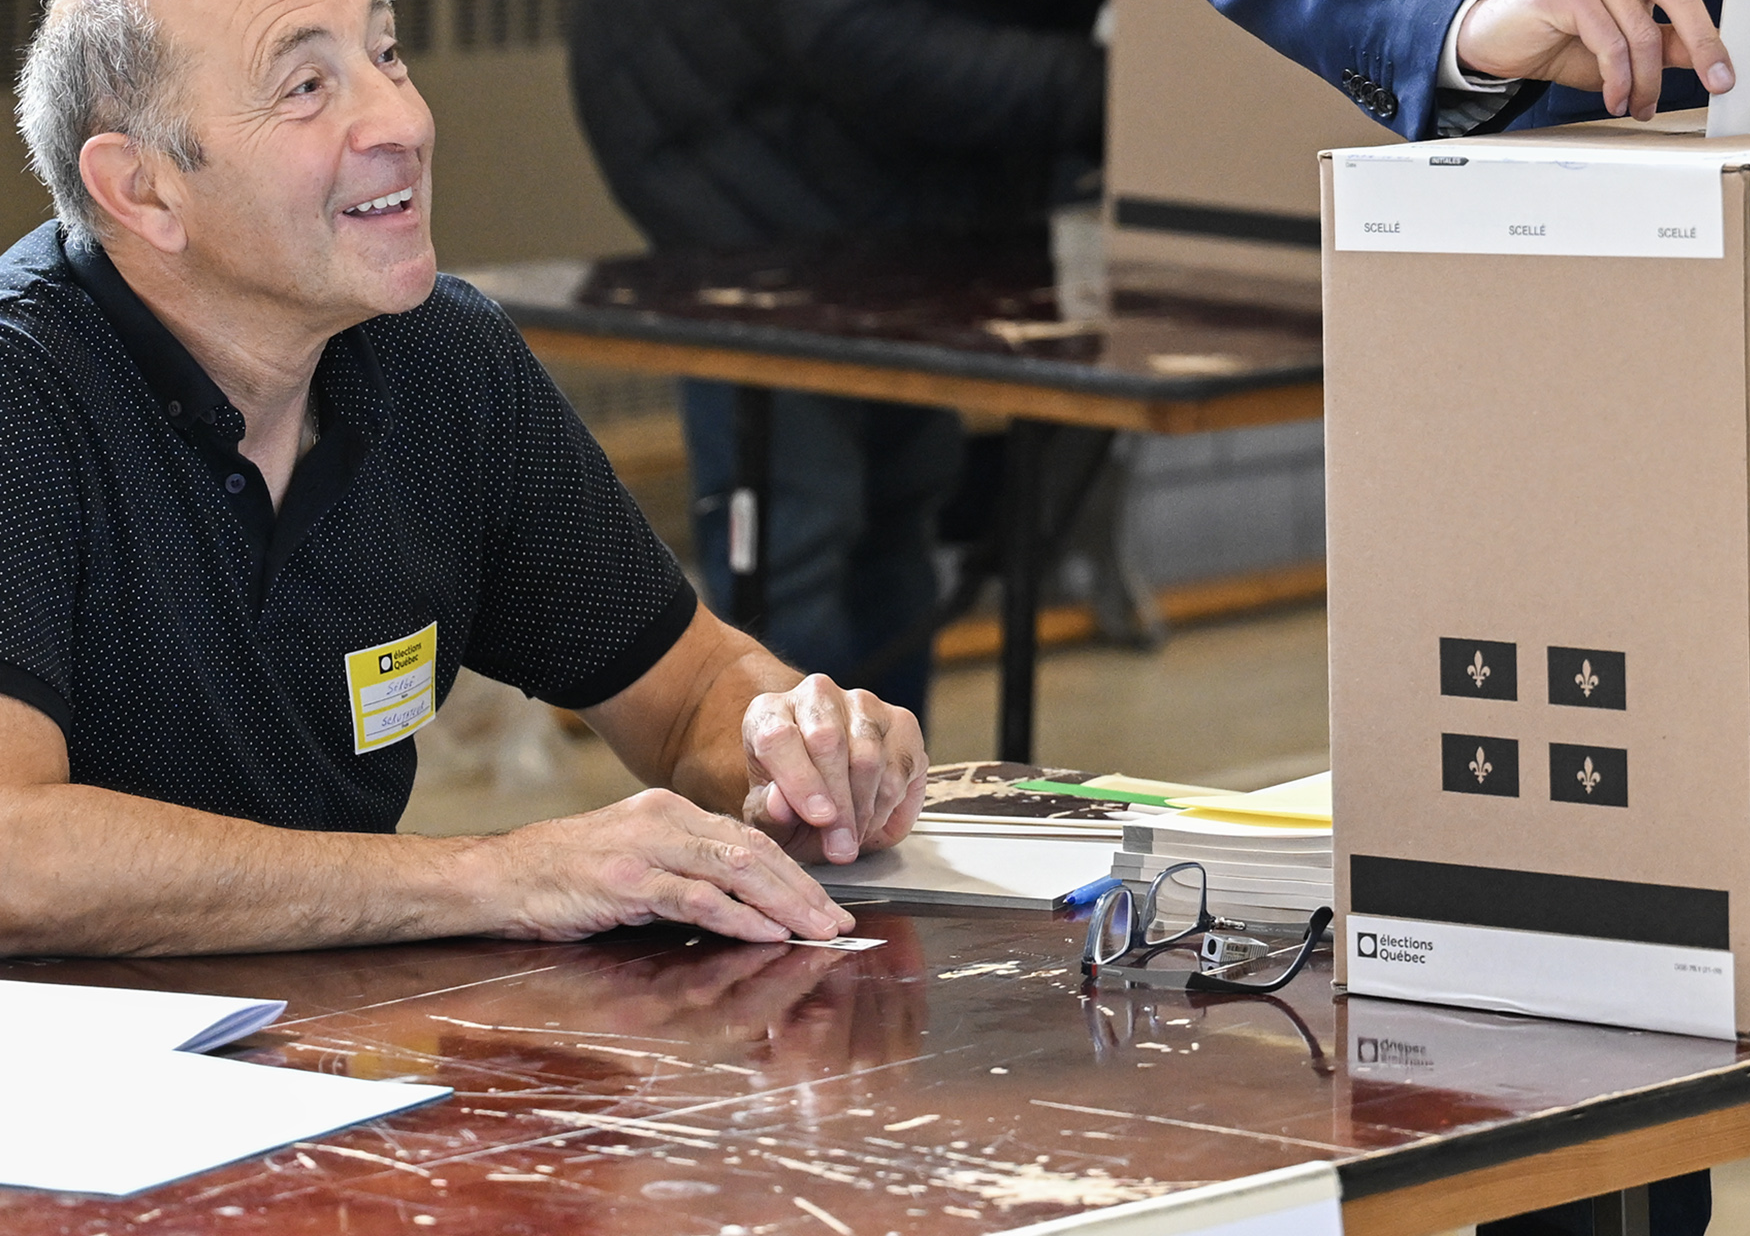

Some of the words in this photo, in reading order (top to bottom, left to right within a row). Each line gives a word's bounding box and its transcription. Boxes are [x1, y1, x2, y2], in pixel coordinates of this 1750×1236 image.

[1364, 221, 1401, 233] SCELLÉ
[1508, 224, 1546, 236] SCELLÉ
[1657, 227, 1697, 239] SCELLÉ
[394, 643, 422, 660] élections
[1380, 934, 1434, 951] élections
[1380, 948, 1426, 964] Québec
